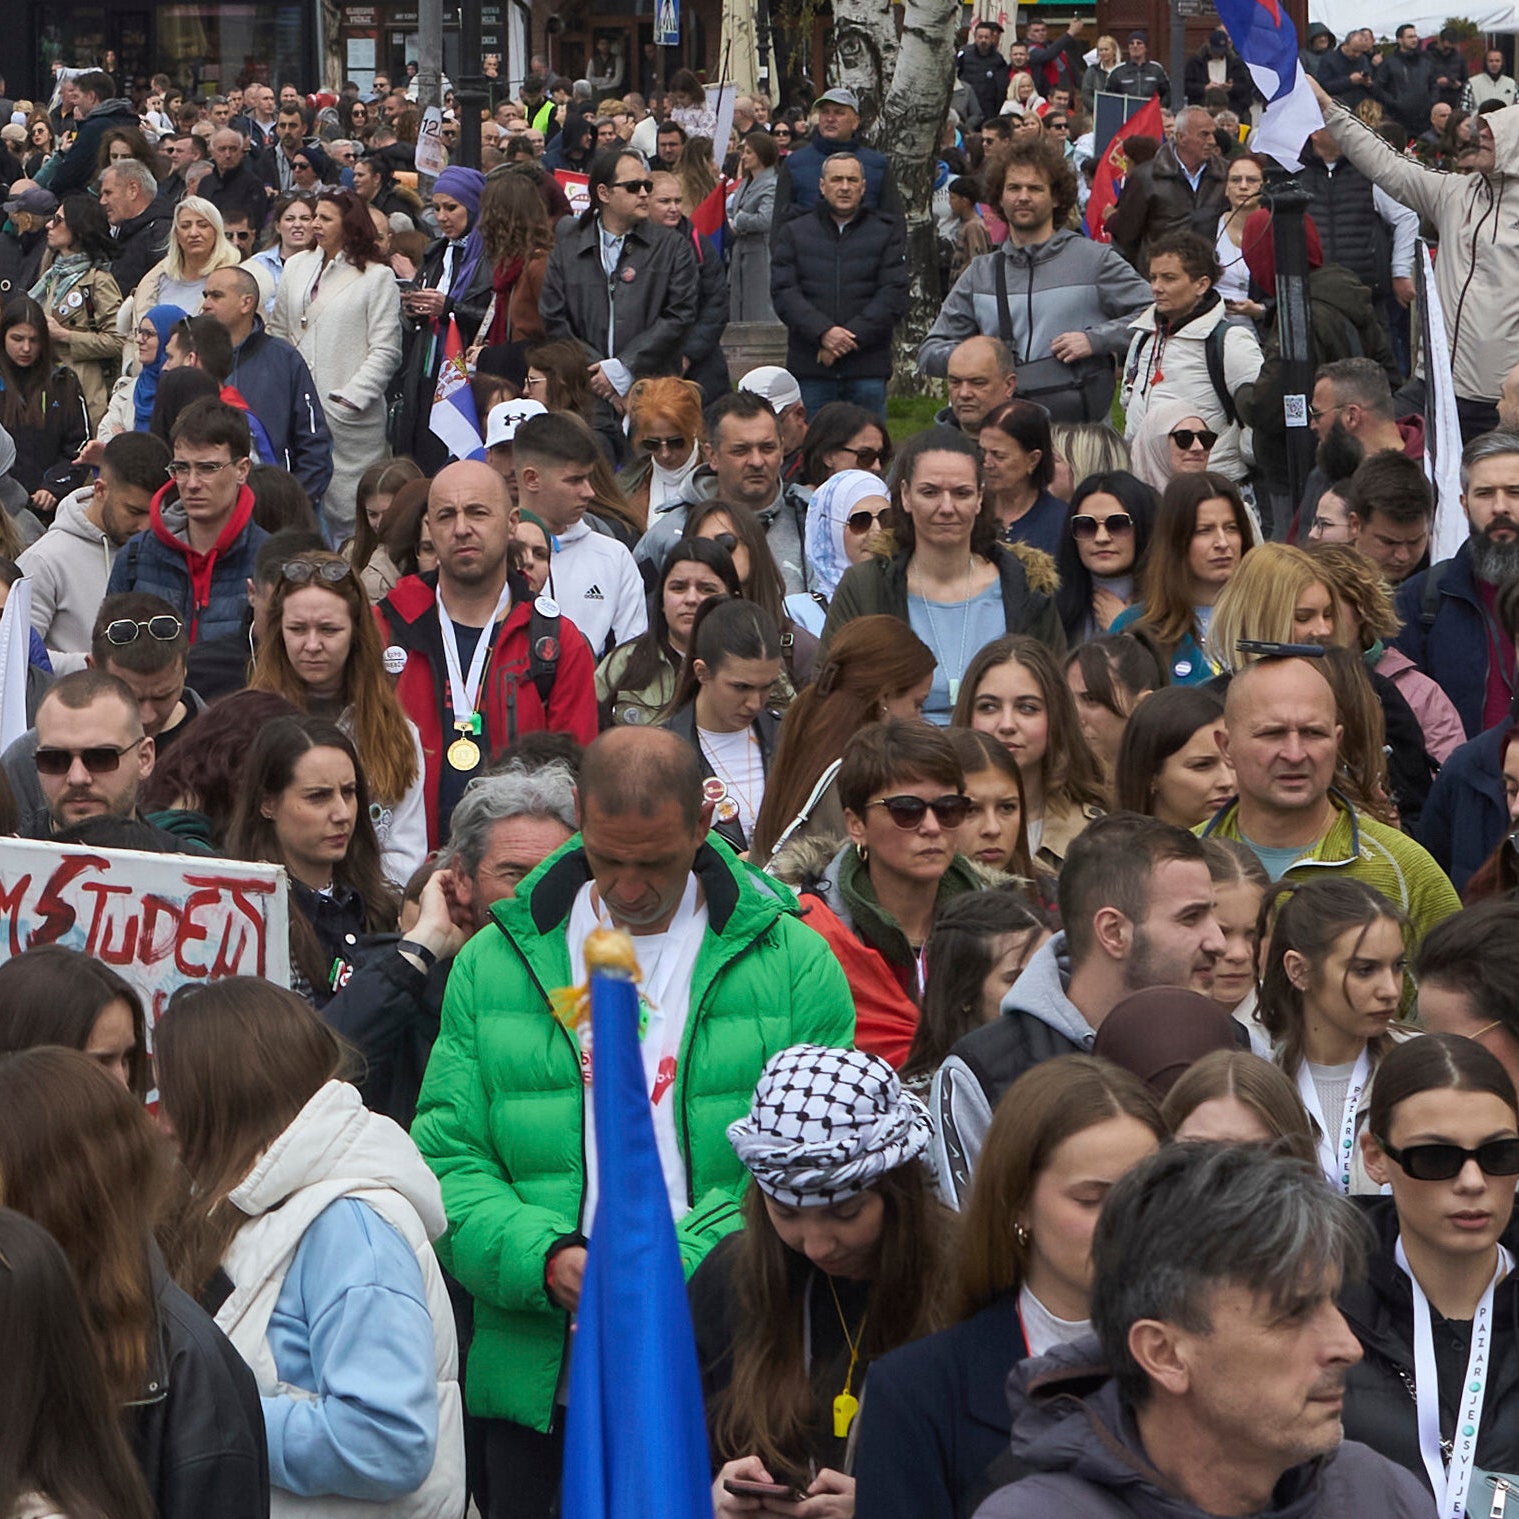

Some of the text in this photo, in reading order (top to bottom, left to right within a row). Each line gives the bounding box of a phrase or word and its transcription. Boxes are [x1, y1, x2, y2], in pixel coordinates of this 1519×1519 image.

[1345, 1086, 1362, 1136] PAZAR
[1452, 1307, 1487, 1519] PAZAR JE SVIJE
